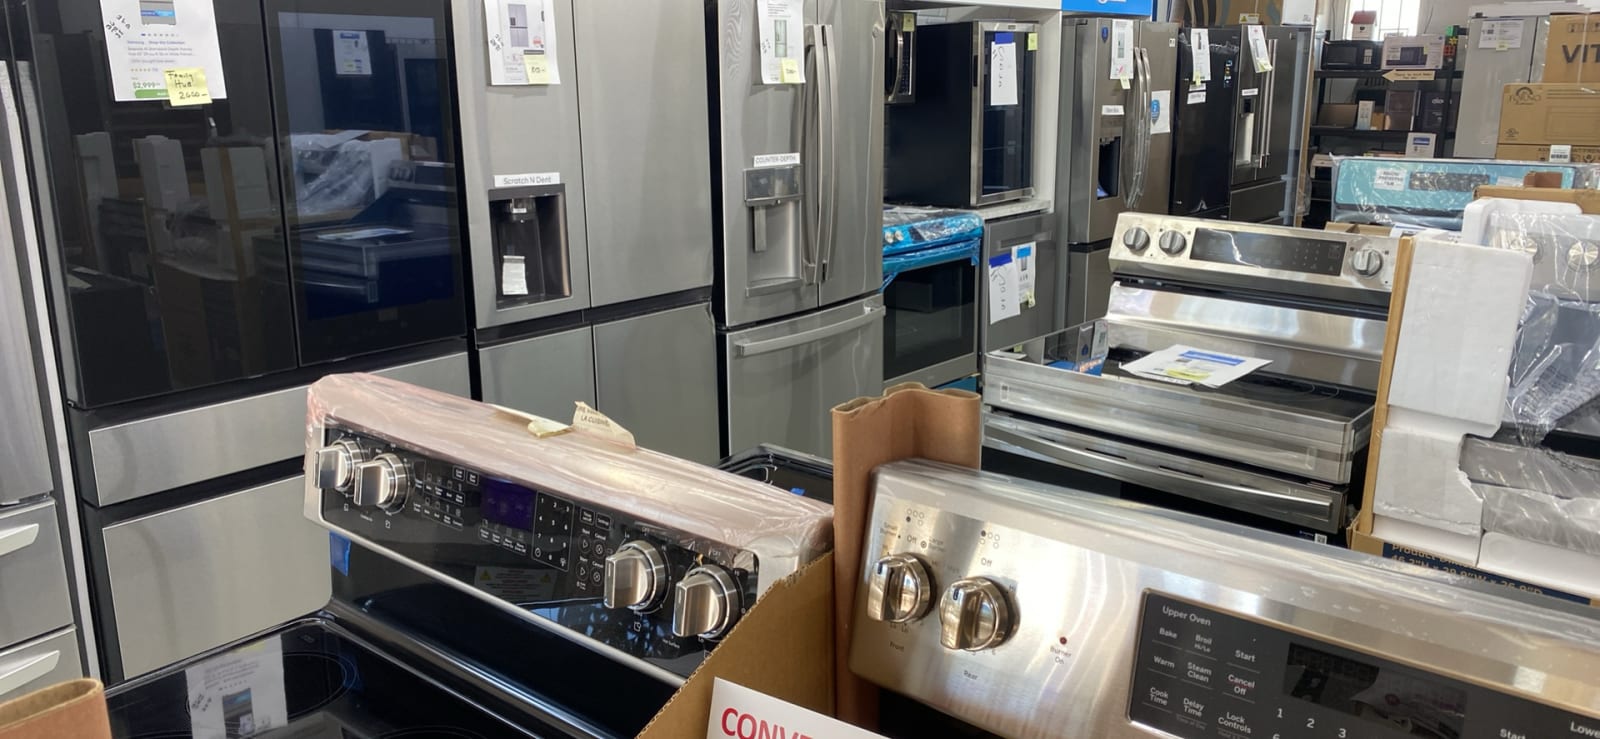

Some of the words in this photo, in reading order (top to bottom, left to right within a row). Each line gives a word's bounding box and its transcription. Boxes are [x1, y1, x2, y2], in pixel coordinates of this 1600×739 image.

[1562, 44, 1600, 64] VIT
[981, 557, 992, 567] Off
[1162, 605, 1188, 619] Upper
[1189, 613, 1211, 626] Oven
[1159, 628, 1177, 639] Bake
[1195, 634, 1212, 645] Broil
[1235, 649, 1255, 662] Start
[1154, 656, 1175, 668] Warm
[1187, 662, 1212, 675] Steam
[963, 670, 978, 680] Rear
[1187, 670, 1209, 682] Clean
[1228, 674, 1255, 688] Cancel
[1150, 687, 1168, 699] Cook
[1234, 686, 1246, 695] Off
[1150, 694, 1167, 706] Time
[1183, 698, 1205, 711] Delay
[1184, 705, 1202, 717] Time
[1277, 708, 1283, 718] 1
[1226, 711, 1245, 724] Lock
[1306, 718, 1315, 728] 2
[1218, 717, 1251, 734] Controls
[1338, 728, 1347, 738] 3
